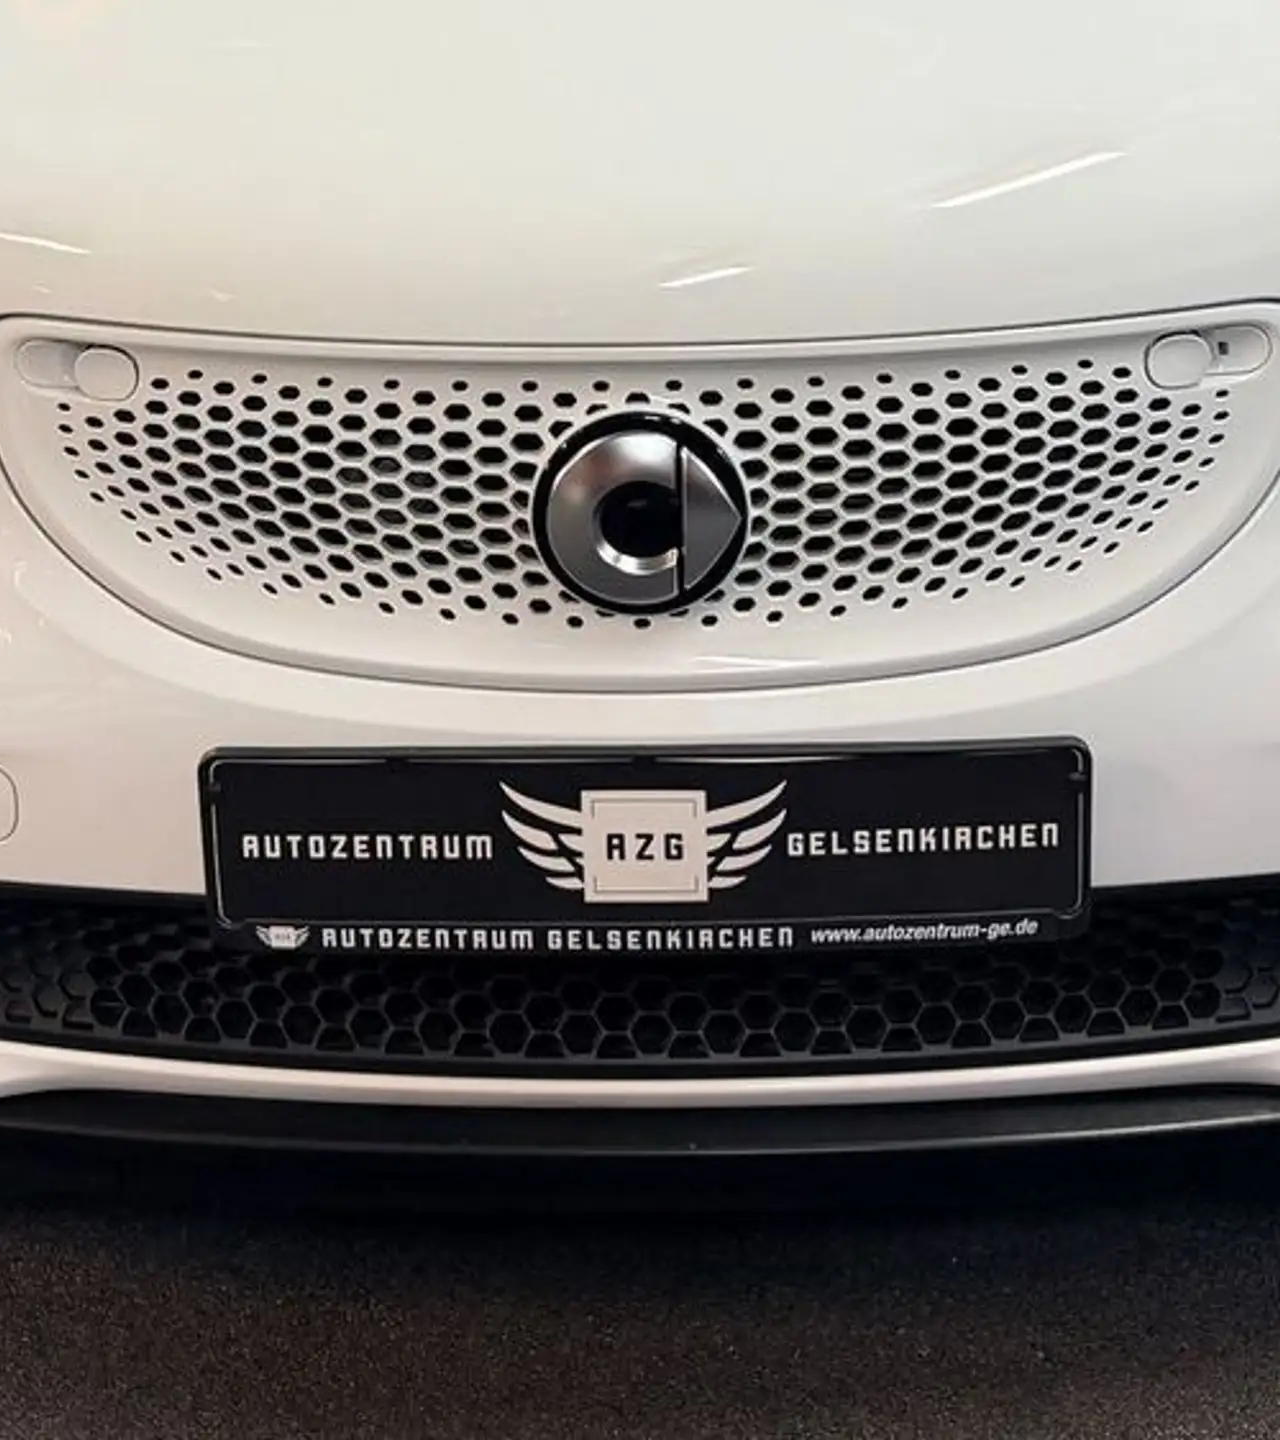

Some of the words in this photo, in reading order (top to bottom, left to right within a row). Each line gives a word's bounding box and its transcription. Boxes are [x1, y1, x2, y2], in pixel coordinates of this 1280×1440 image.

[242, 834, 493, 859] AUTOZENTRUM
[606, 833, 685, 861] AZG
[787, 823, 1060, 857] GELSENKIRCHEN
[322, 927, 534, 949] AUTOZENTRUM
[547, 927, 793, 950] GELSENKIRCHEN
[811, 918, 1039, 943] www.autozentrum-ge.de
